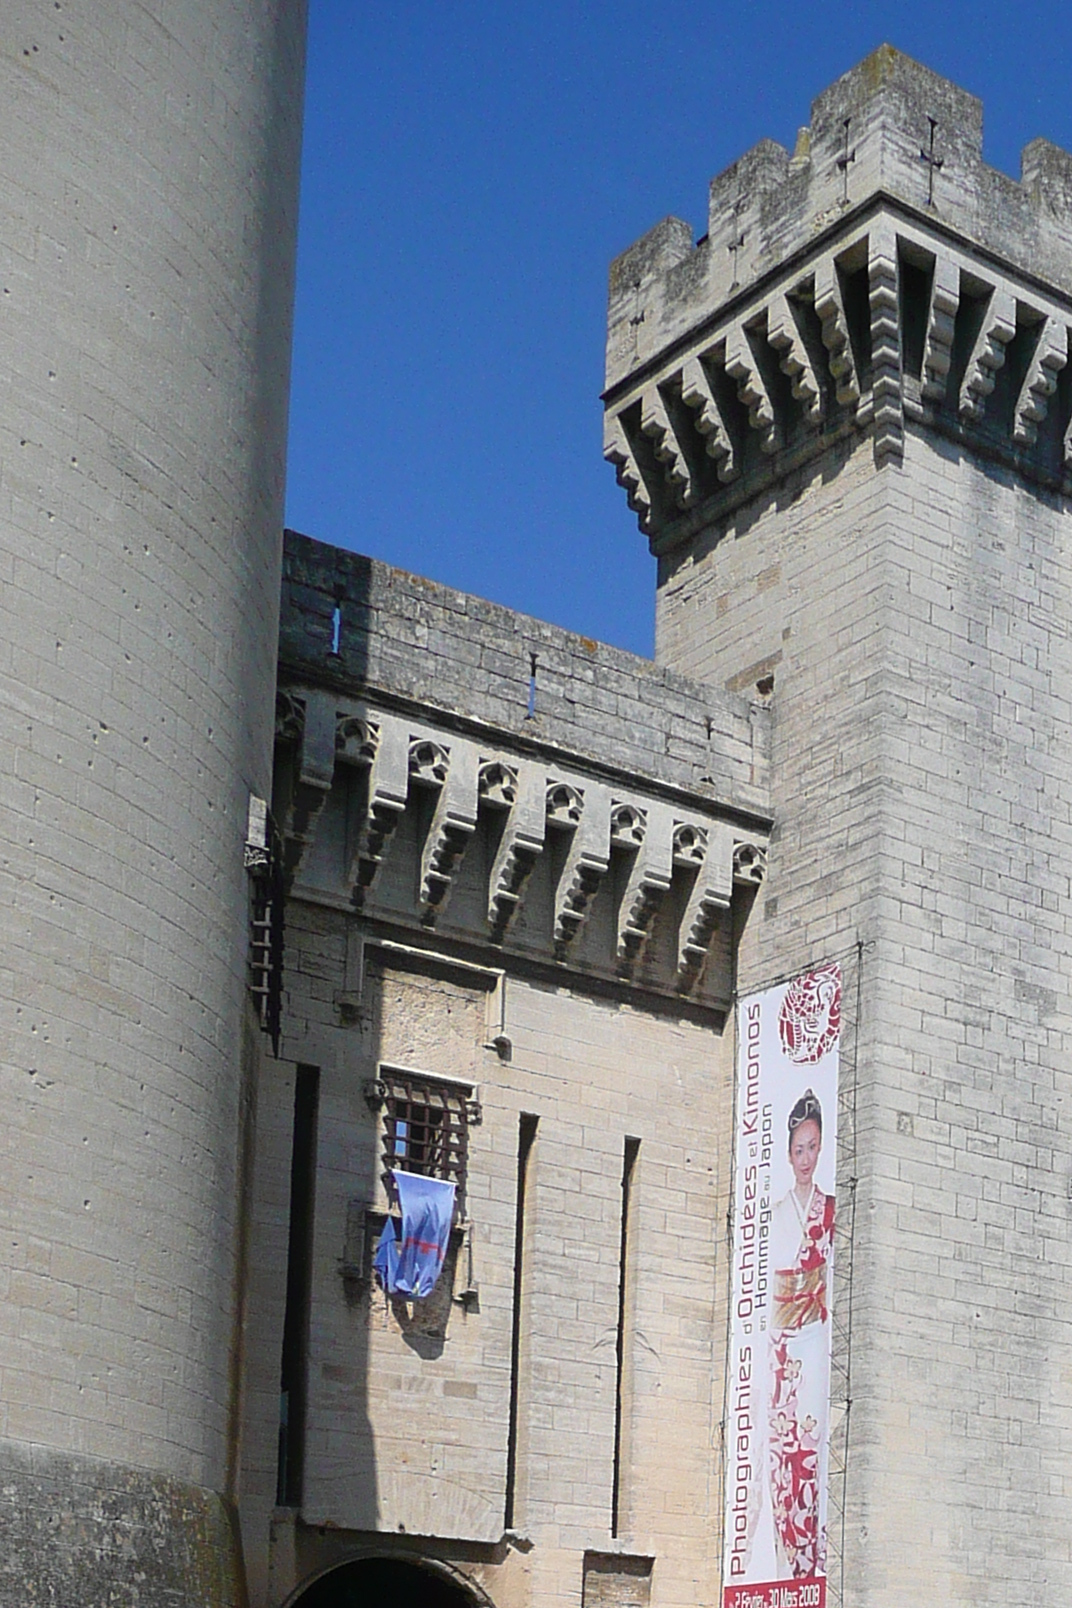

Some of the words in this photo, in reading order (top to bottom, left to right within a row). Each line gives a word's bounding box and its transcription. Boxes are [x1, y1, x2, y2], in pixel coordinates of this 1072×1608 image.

[742, 1003, 760, 1136] Kimonos
[748, 1141, 758, 1158] et
[758, 1103, 774, 1168] Japon
[763, 1175, 771, 1191] au
[754, 1195, 772, 1309] Hommage
[760, 1315, 767, 1332] en
[730, 1346, 753, 1577] Photographies
[780, 1587, 798, 1608] Mars
